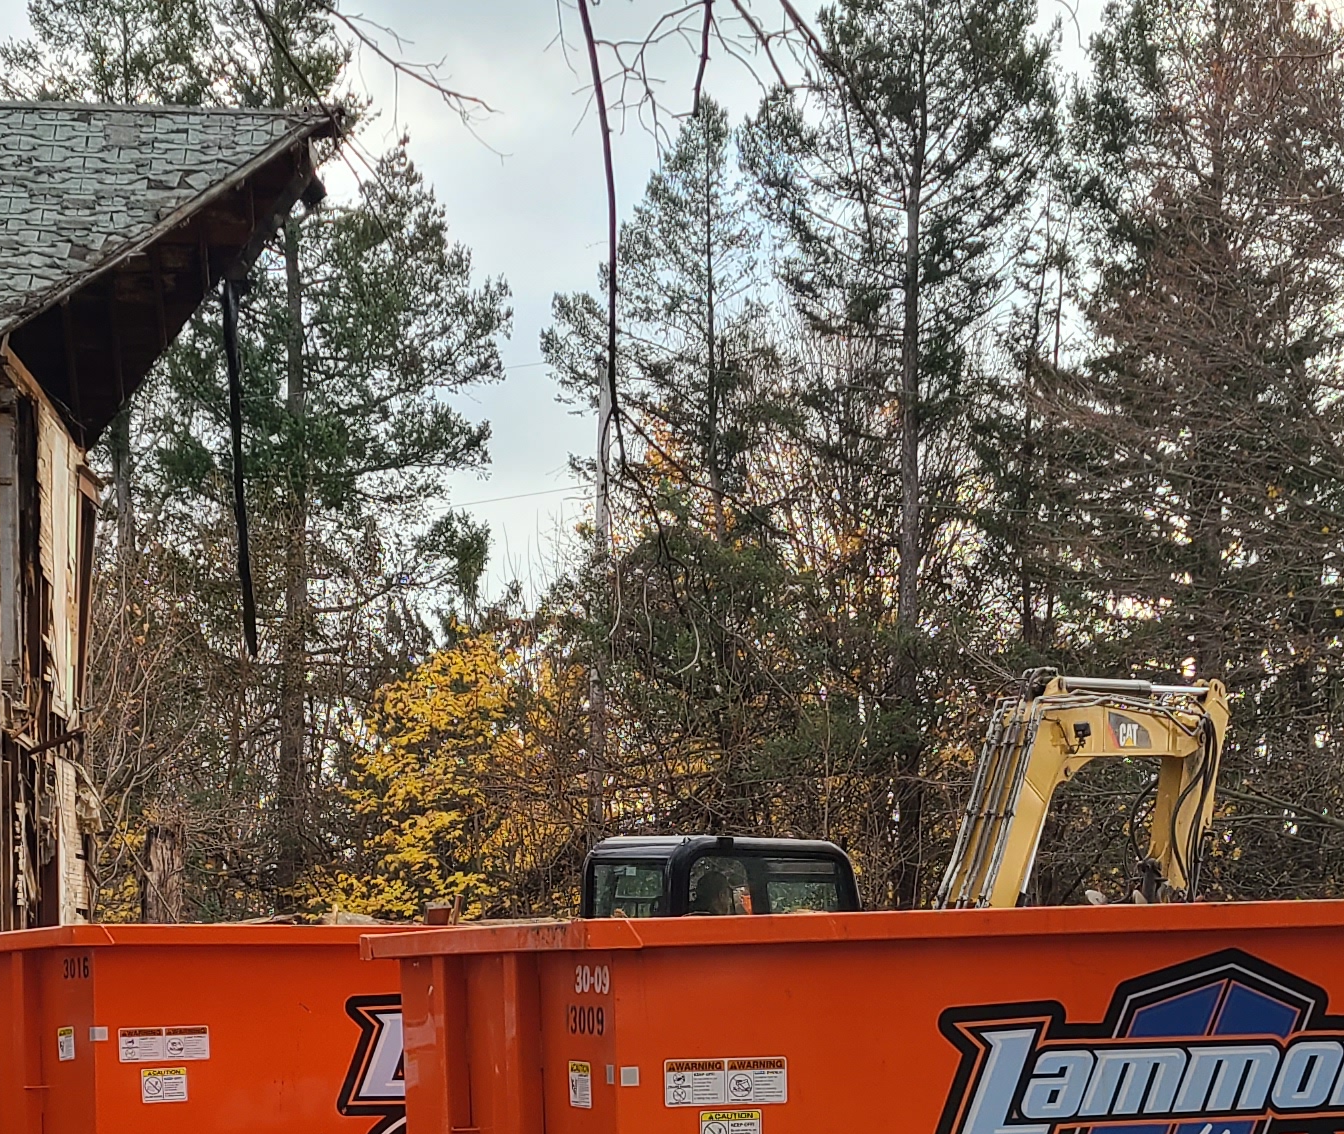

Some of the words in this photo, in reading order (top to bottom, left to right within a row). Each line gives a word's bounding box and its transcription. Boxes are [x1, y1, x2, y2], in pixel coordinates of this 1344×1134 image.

[1119, 723, 1139, 747] CAT
[63, 957, 90, 979] 3016
[575, 965, 610, 994] 30-09
[570, 1005, 604, 1036] 3009
[676, 1061, 722, 1071] WARNING
[737, 1060, 783, 1070] WARNING
[715, 1112, 754, 1120] CAUTION
